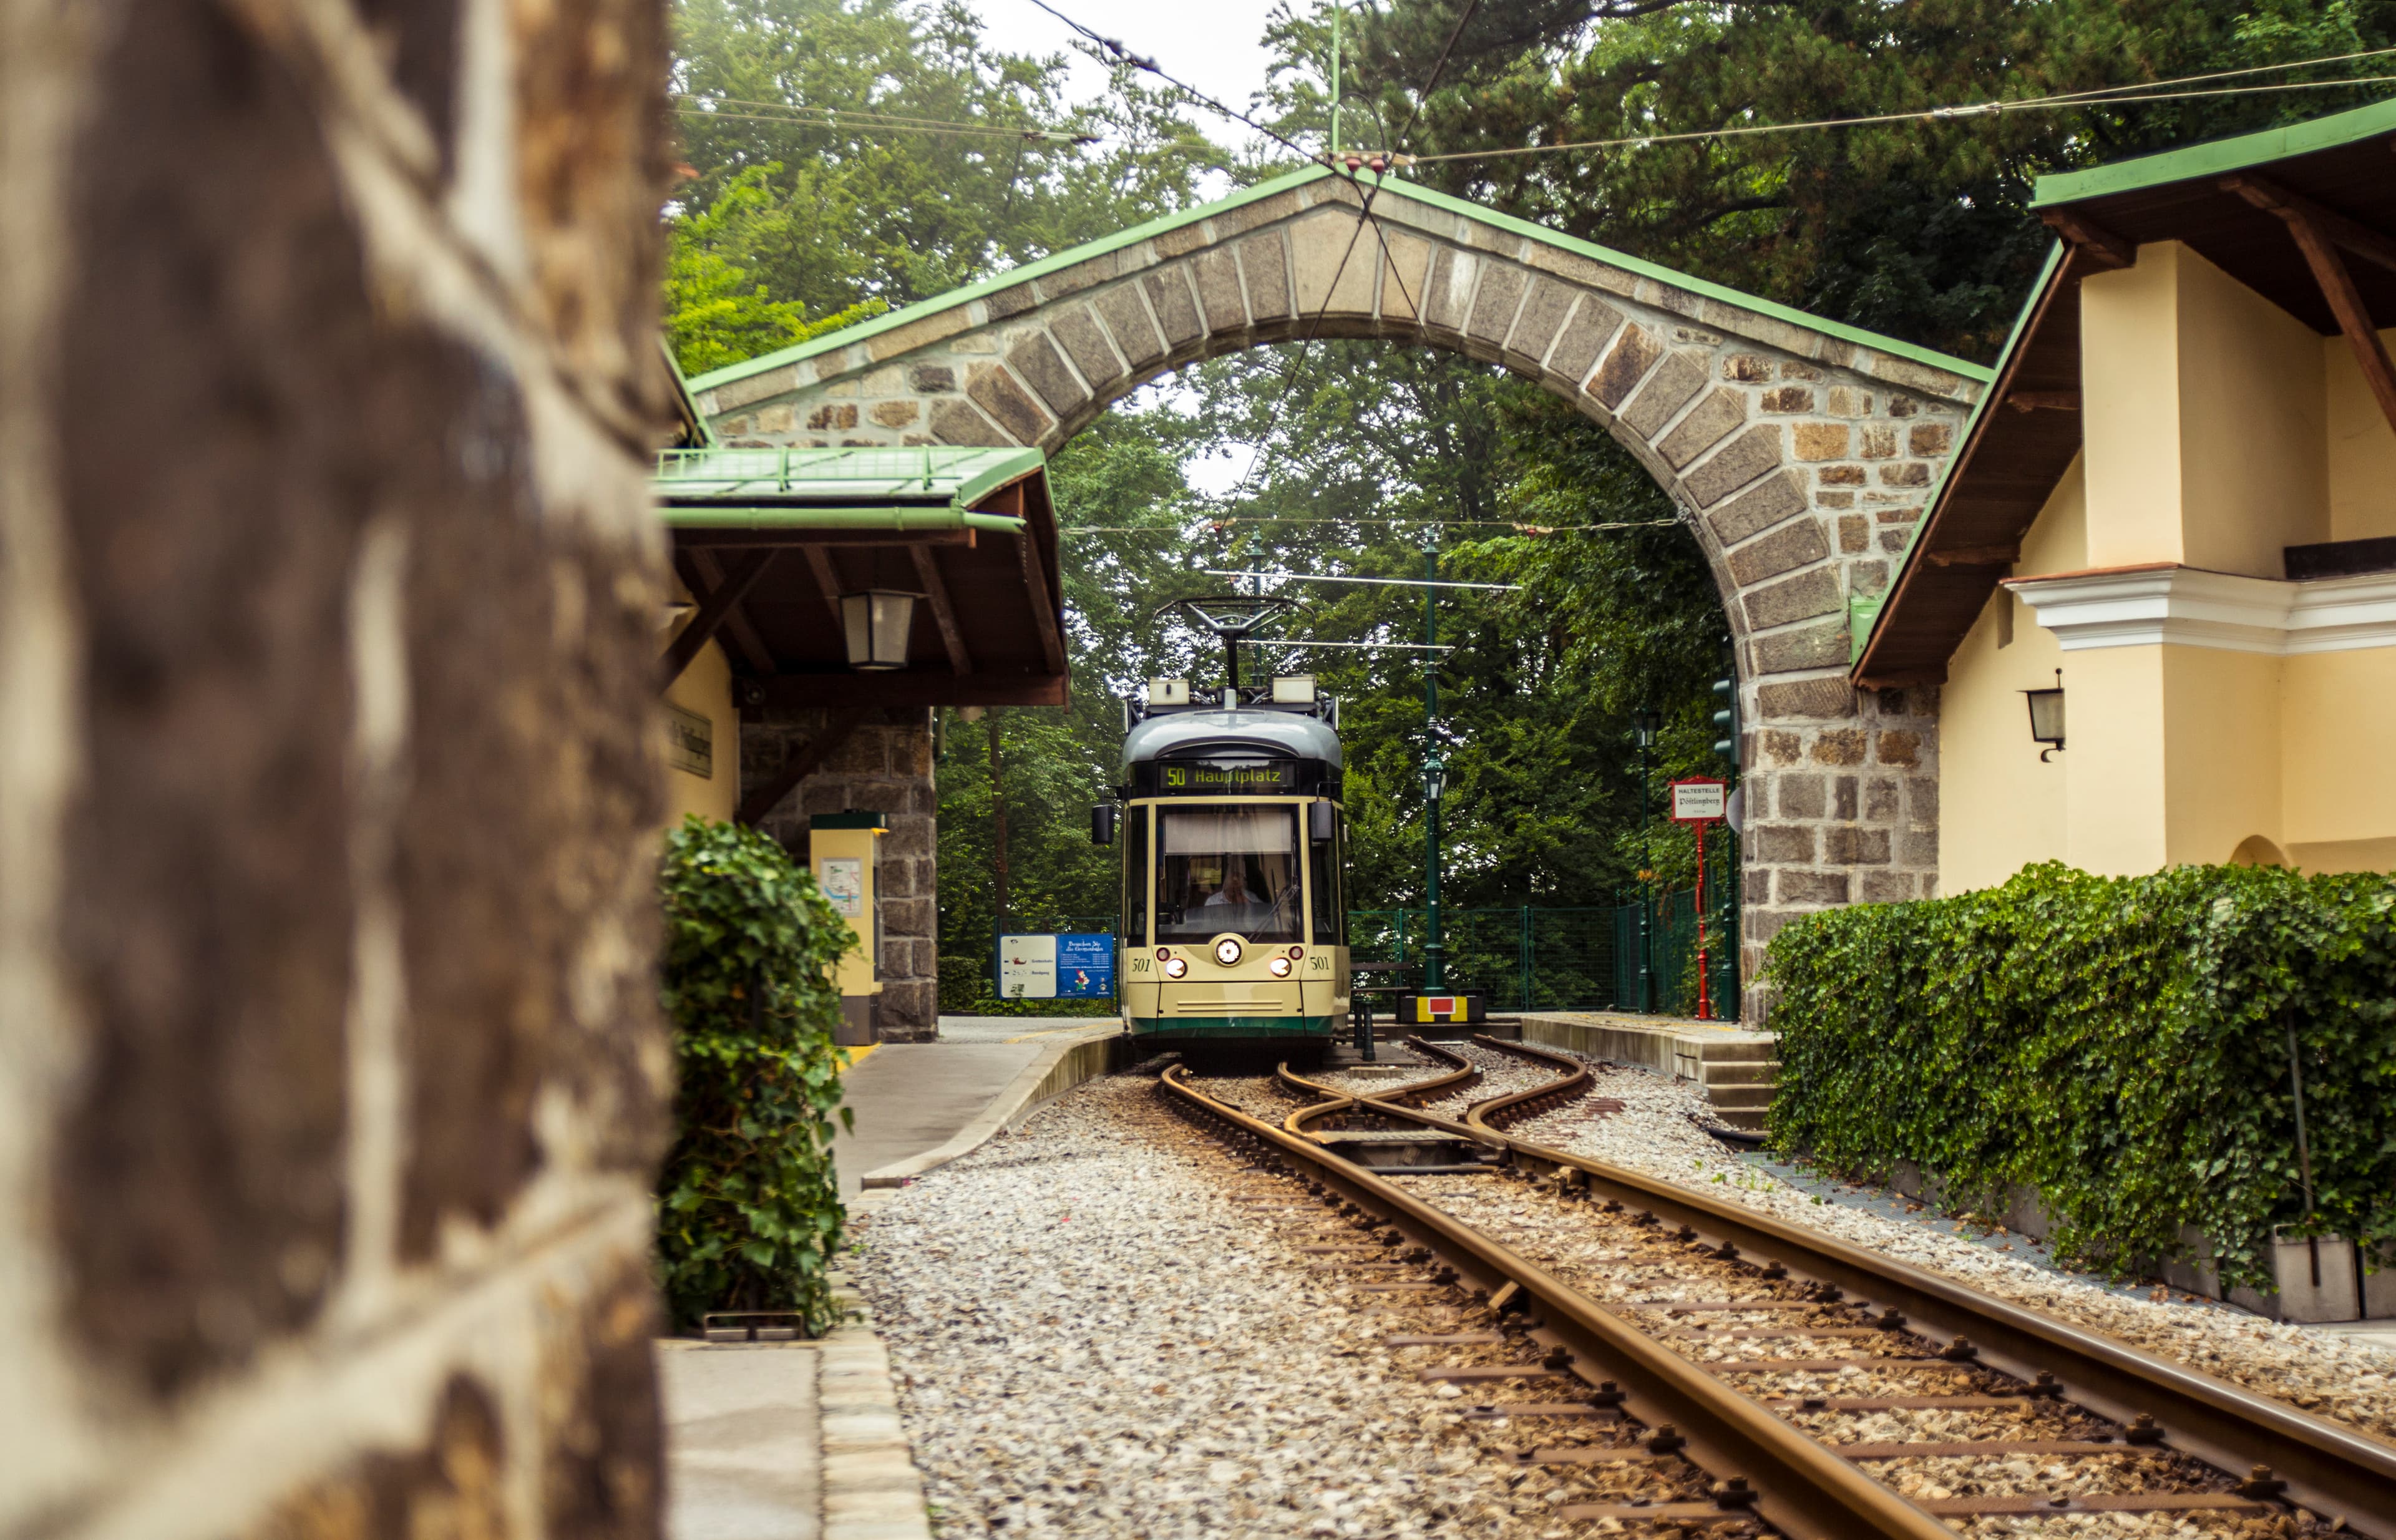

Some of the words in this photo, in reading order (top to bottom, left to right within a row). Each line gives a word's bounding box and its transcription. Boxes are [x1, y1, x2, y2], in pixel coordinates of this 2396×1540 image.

[1168, 768, 1186, 786] 50
[1196, 769, 1280, 784] Hauptplatz
[1132, 958, 1151, 972] 501
[1310, 956, 1330, 970] 501
